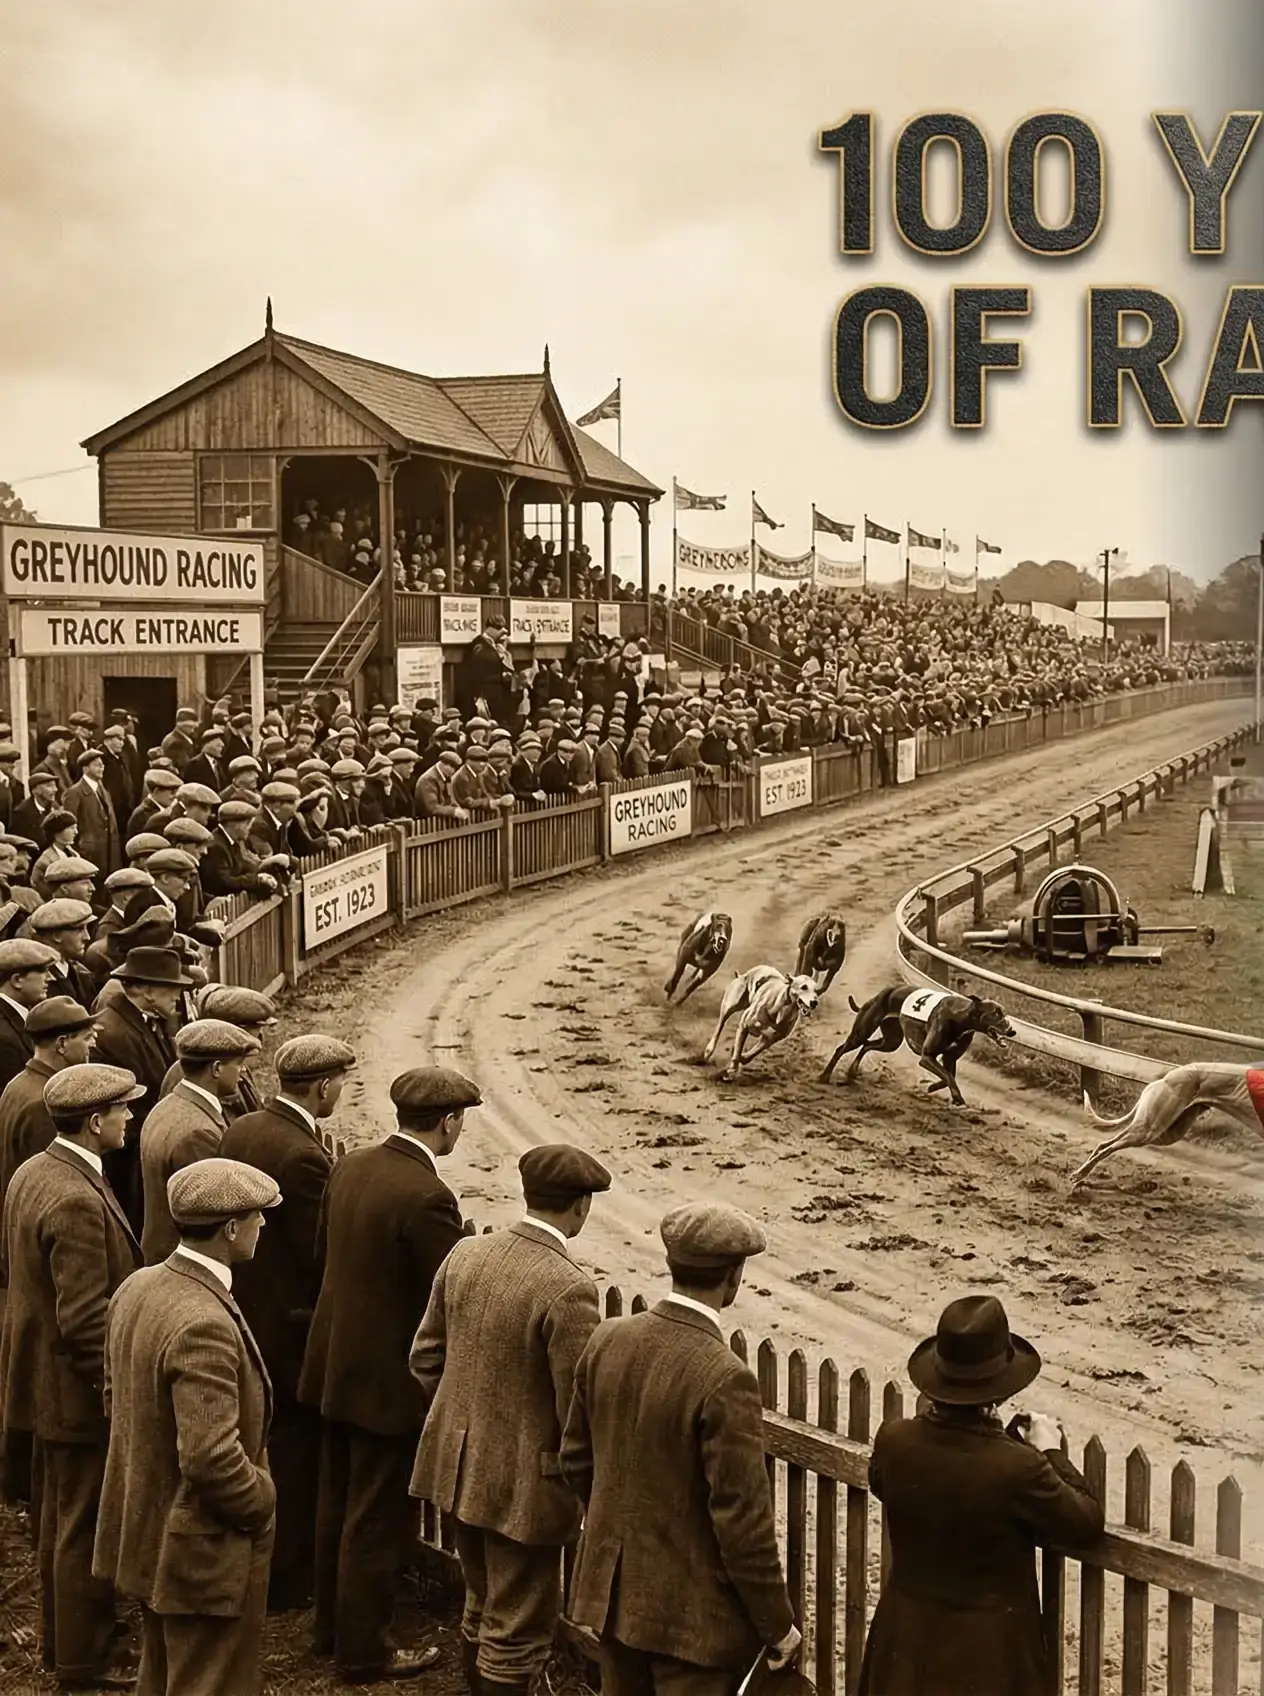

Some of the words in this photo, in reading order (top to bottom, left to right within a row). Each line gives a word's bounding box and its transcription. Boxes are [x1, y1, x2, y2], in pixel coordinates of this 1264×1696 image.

[10, 538, 168, 587] GREYHOUND
[176, 549, 257, 589] RACING
[47, 618, 126, 645] TRACK
[135, 619, 240, 644] ENTRANCE
[614, 788, 688, 822] GREYHOUND
[628, 815, 676, 841] RACING
[315, 897, 342, 932] EST.
[346, 883, 375, 917] 1923
